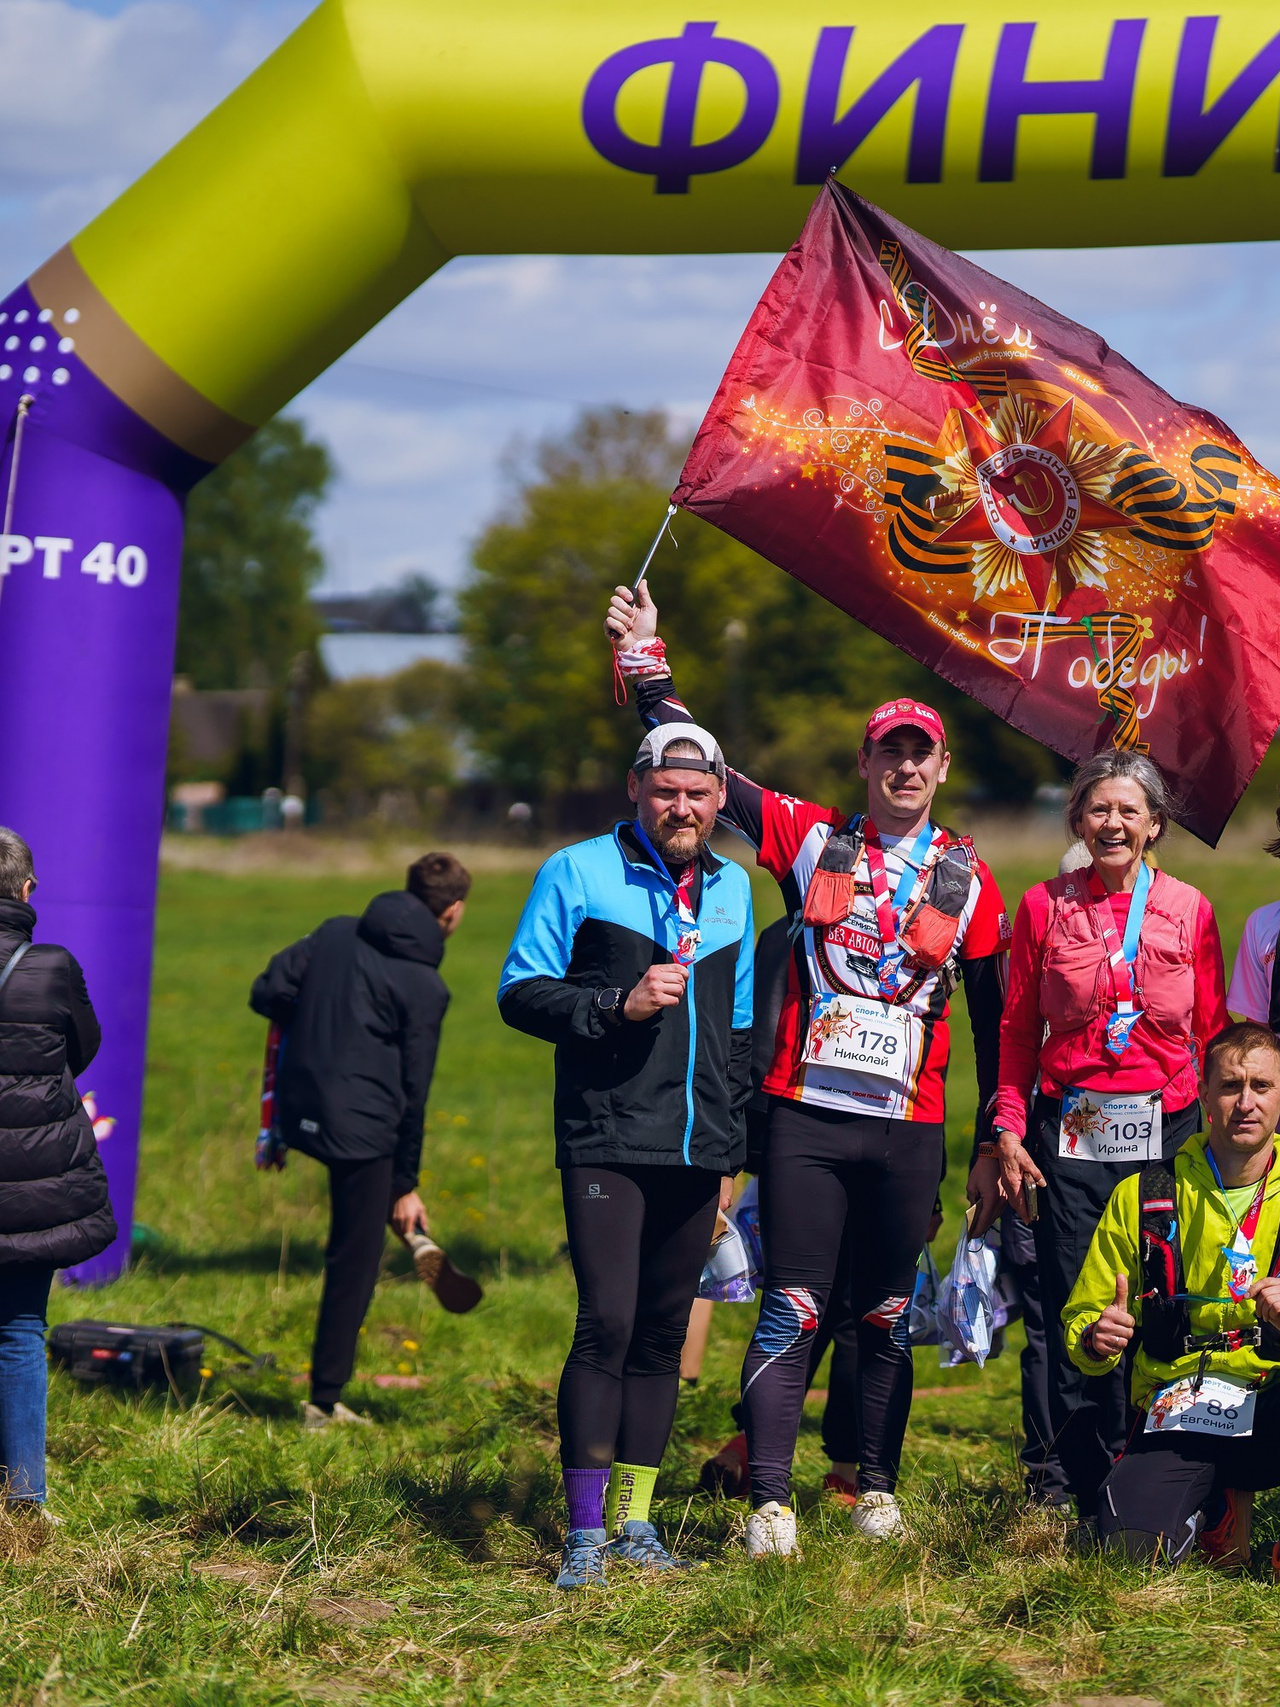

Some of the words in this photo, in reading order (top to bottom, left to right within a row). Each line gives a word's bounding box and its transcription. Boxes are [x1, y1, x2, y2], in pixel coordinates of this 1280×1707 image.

[1064, 367, 1100, 392] 1941-1945
[81, 542, 149, 588] 40
[928, 611, 949, 631] Наша
[949, 625, 980, 651] победа!
[828, 926, 846, 943] БЕЗ
[855, 1007, 879, 1017] СПОРТ
[858, 1030, 898, 1055] 178
[834, 1047, 889, 1067] Николай
[1110, 1121, 1152, 1141] 103
[1098, 1143, 1138, 1156] Ирина
[1202, 1380, 1221, 1388] ПОРТ
[1207, 1398, 1239, 1420] 86
[1180, 1414, 1235, 1430] Евгений
